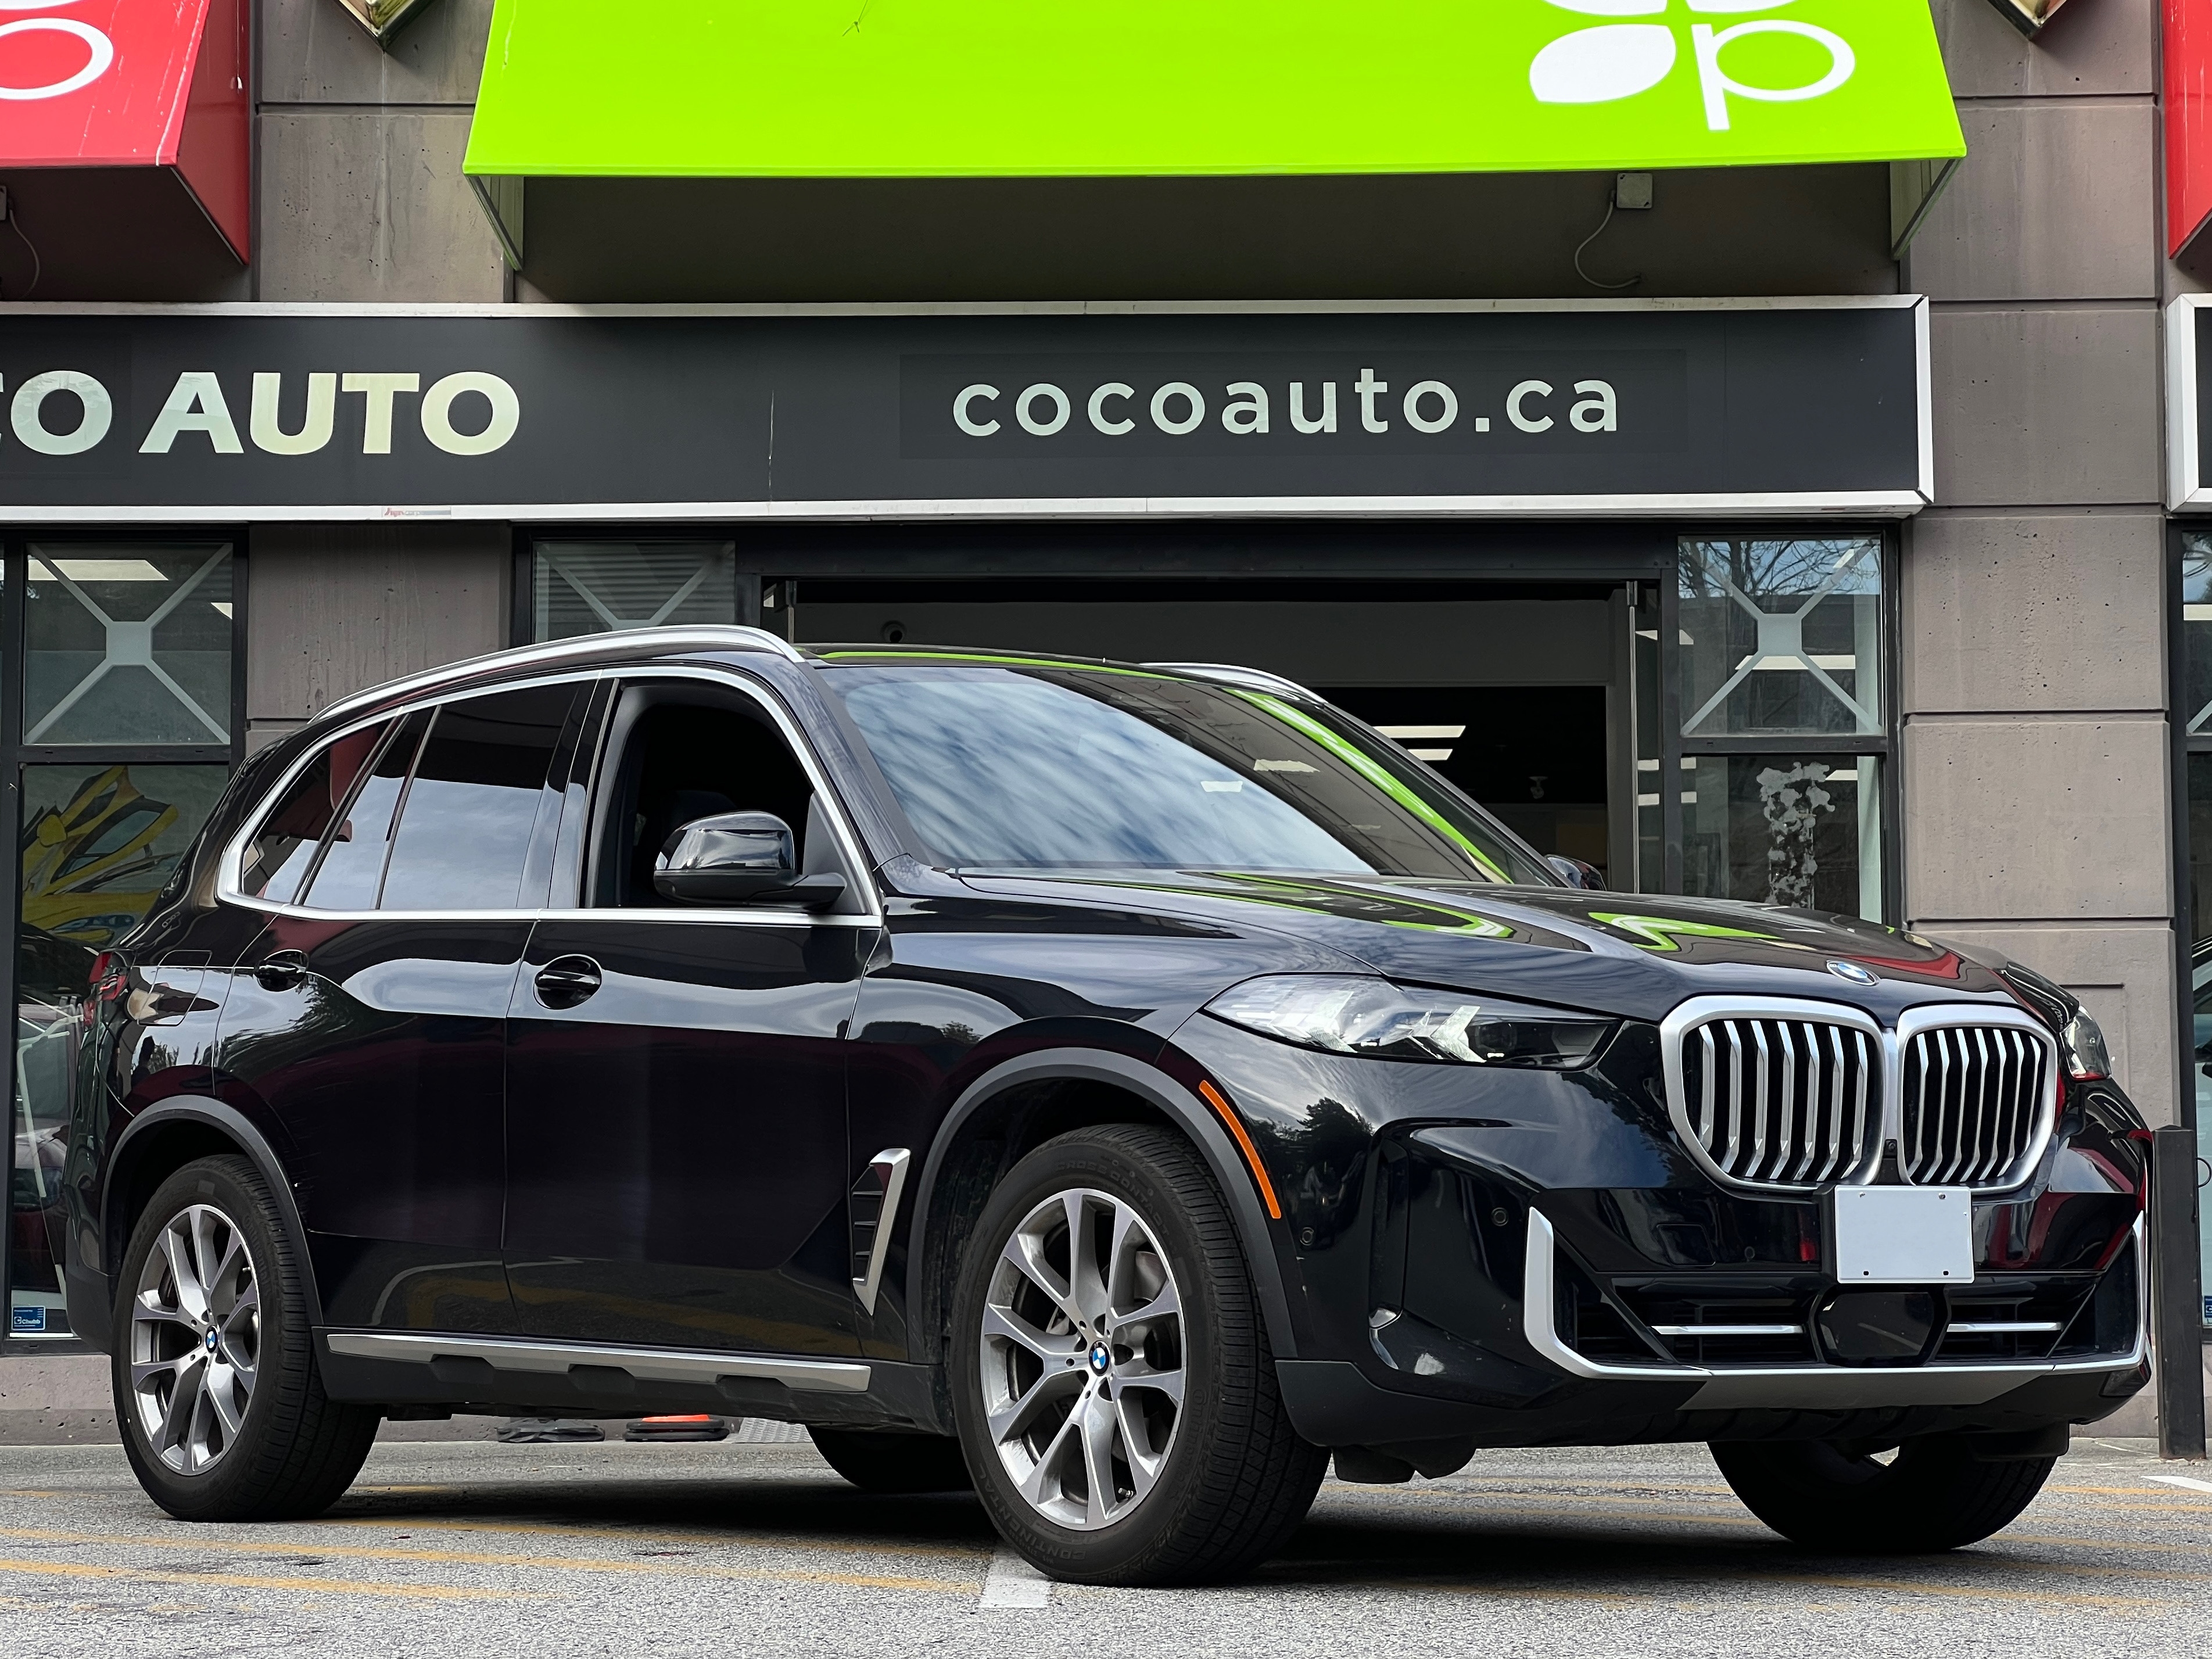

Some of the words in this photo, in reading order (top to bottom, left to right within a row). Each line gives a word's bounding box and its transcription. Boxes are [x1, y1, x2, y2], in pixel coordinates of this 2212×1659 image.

[0, 371, 112, 454] O
[139, 372, 519, 455] AUTO
[953, 369, 1616, 436] cocoauto.ca
